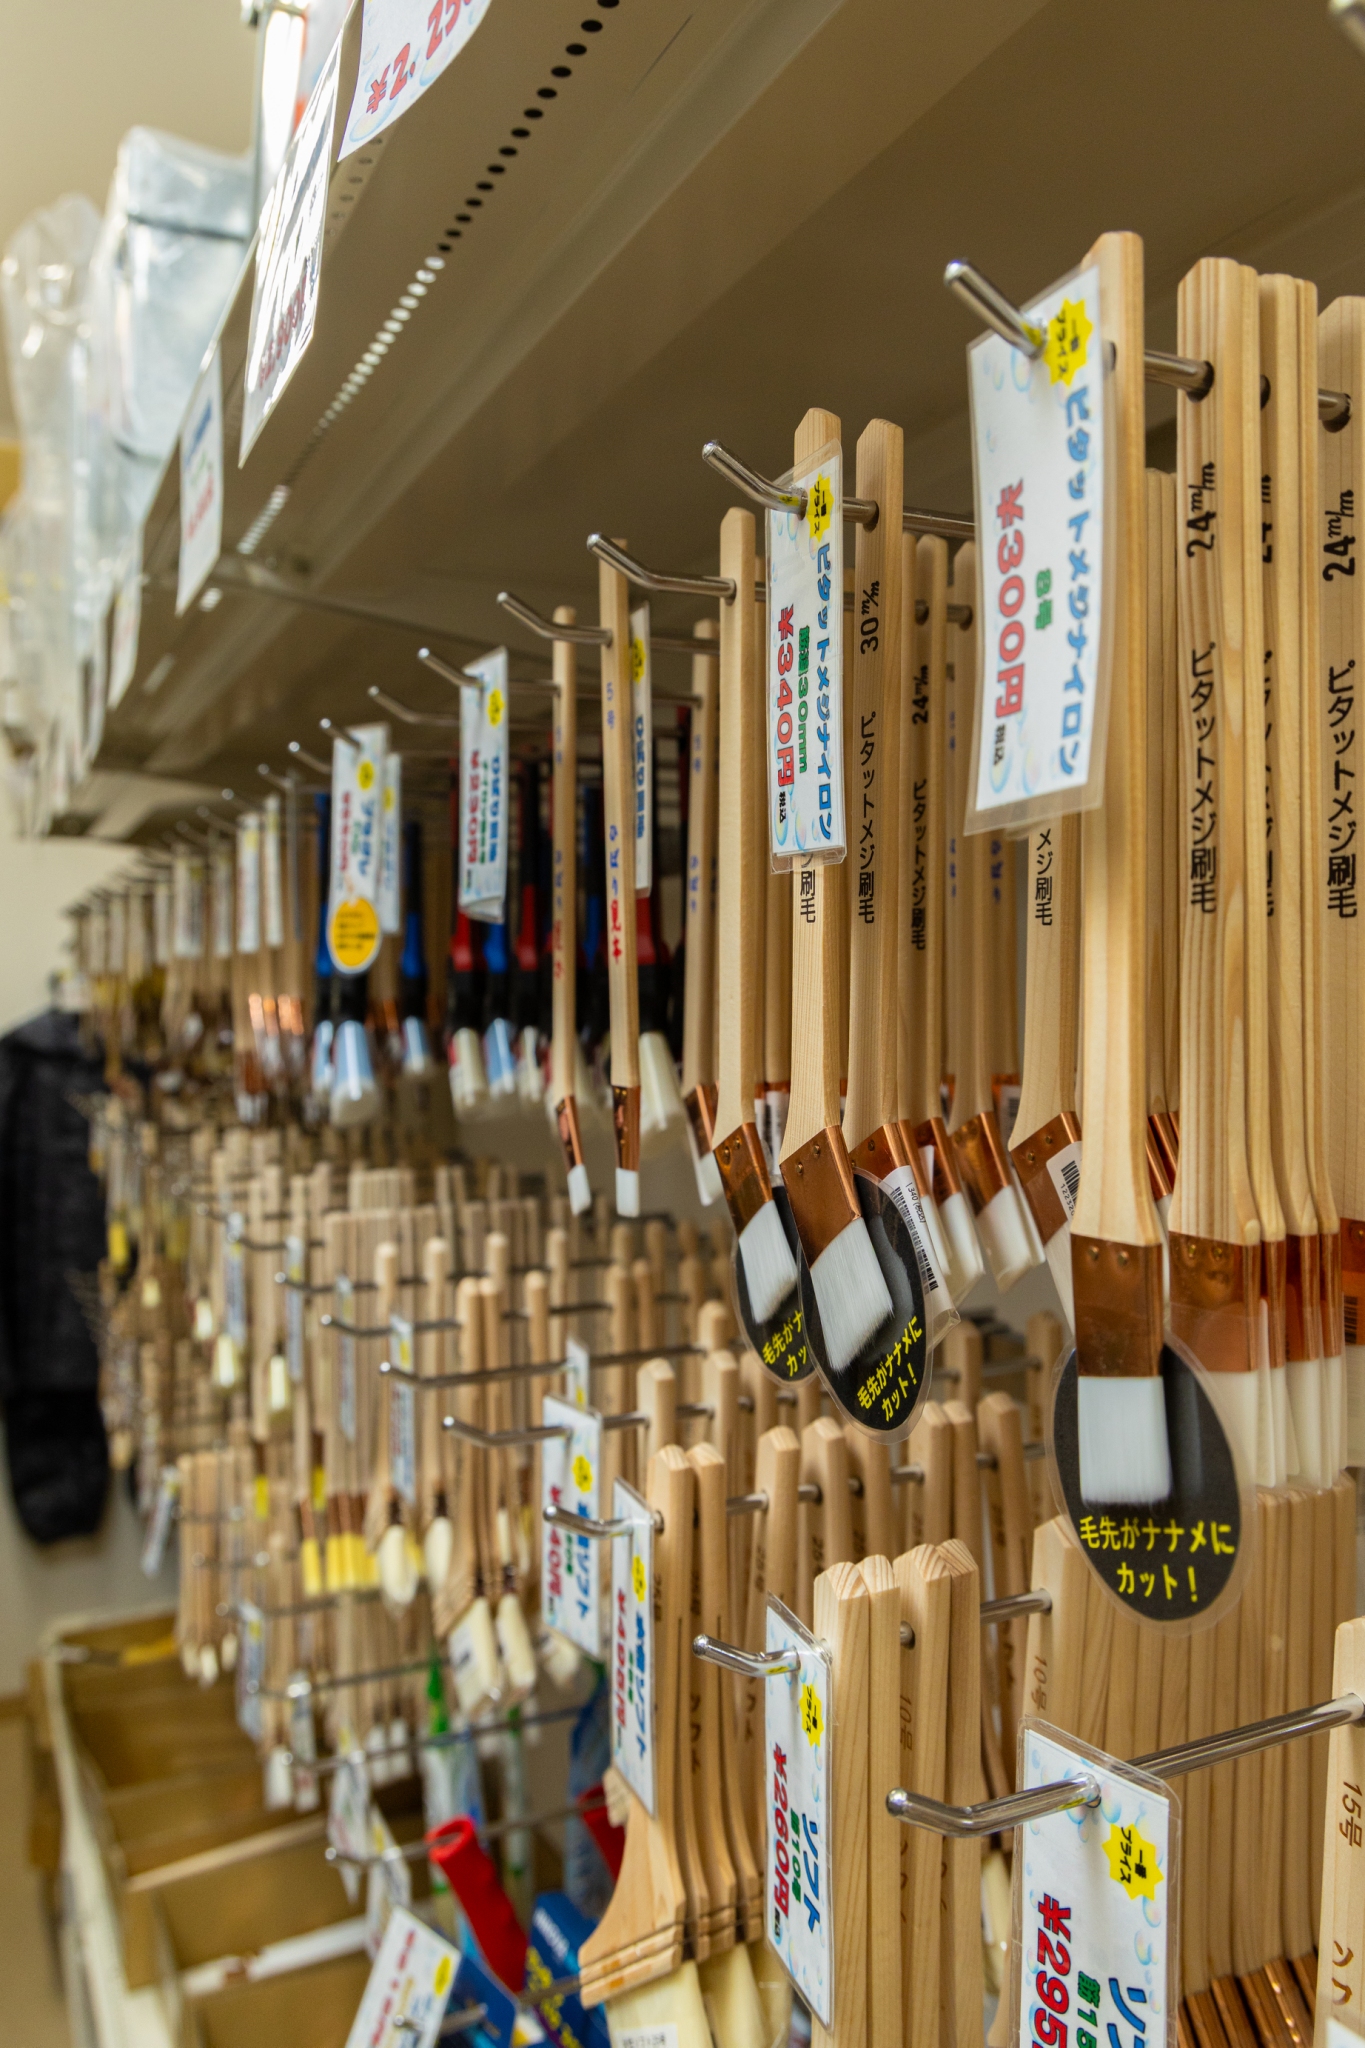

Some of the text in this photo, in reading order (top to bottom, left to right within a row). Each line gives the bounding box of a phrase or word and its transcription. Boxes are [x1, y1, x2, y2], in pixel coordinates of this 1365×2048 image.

[996, 478, 1026, 719] ¥300円
[1060, 385, 1090, 776] ピタットメジナイロン
[777, 604, 795, 787] ¥340円
[817, 542, 833, 840] ピタットメジナイロン
[1190, 641, 1217, 914] ピタットメジ刷毛
[858, 711, 876, 924] ピタットメジ刷毛
[911, 779, 928, 950] ピタットメジ刷毛
[1327, 659, 1357, 918] ピタットメジ刷毛
[857, 1316, 923, 1409] 毛先がナナメに
[1079, 1515, 1235, 1555] 毛先がナナメに
[773, 1742, 790, 1918] ¥260円
[802, 1813, 821, 1933] ソフト
[1338, 1780, 1363, 1848] 15号
[1032, 1893, 1072, 2048] ¥295
